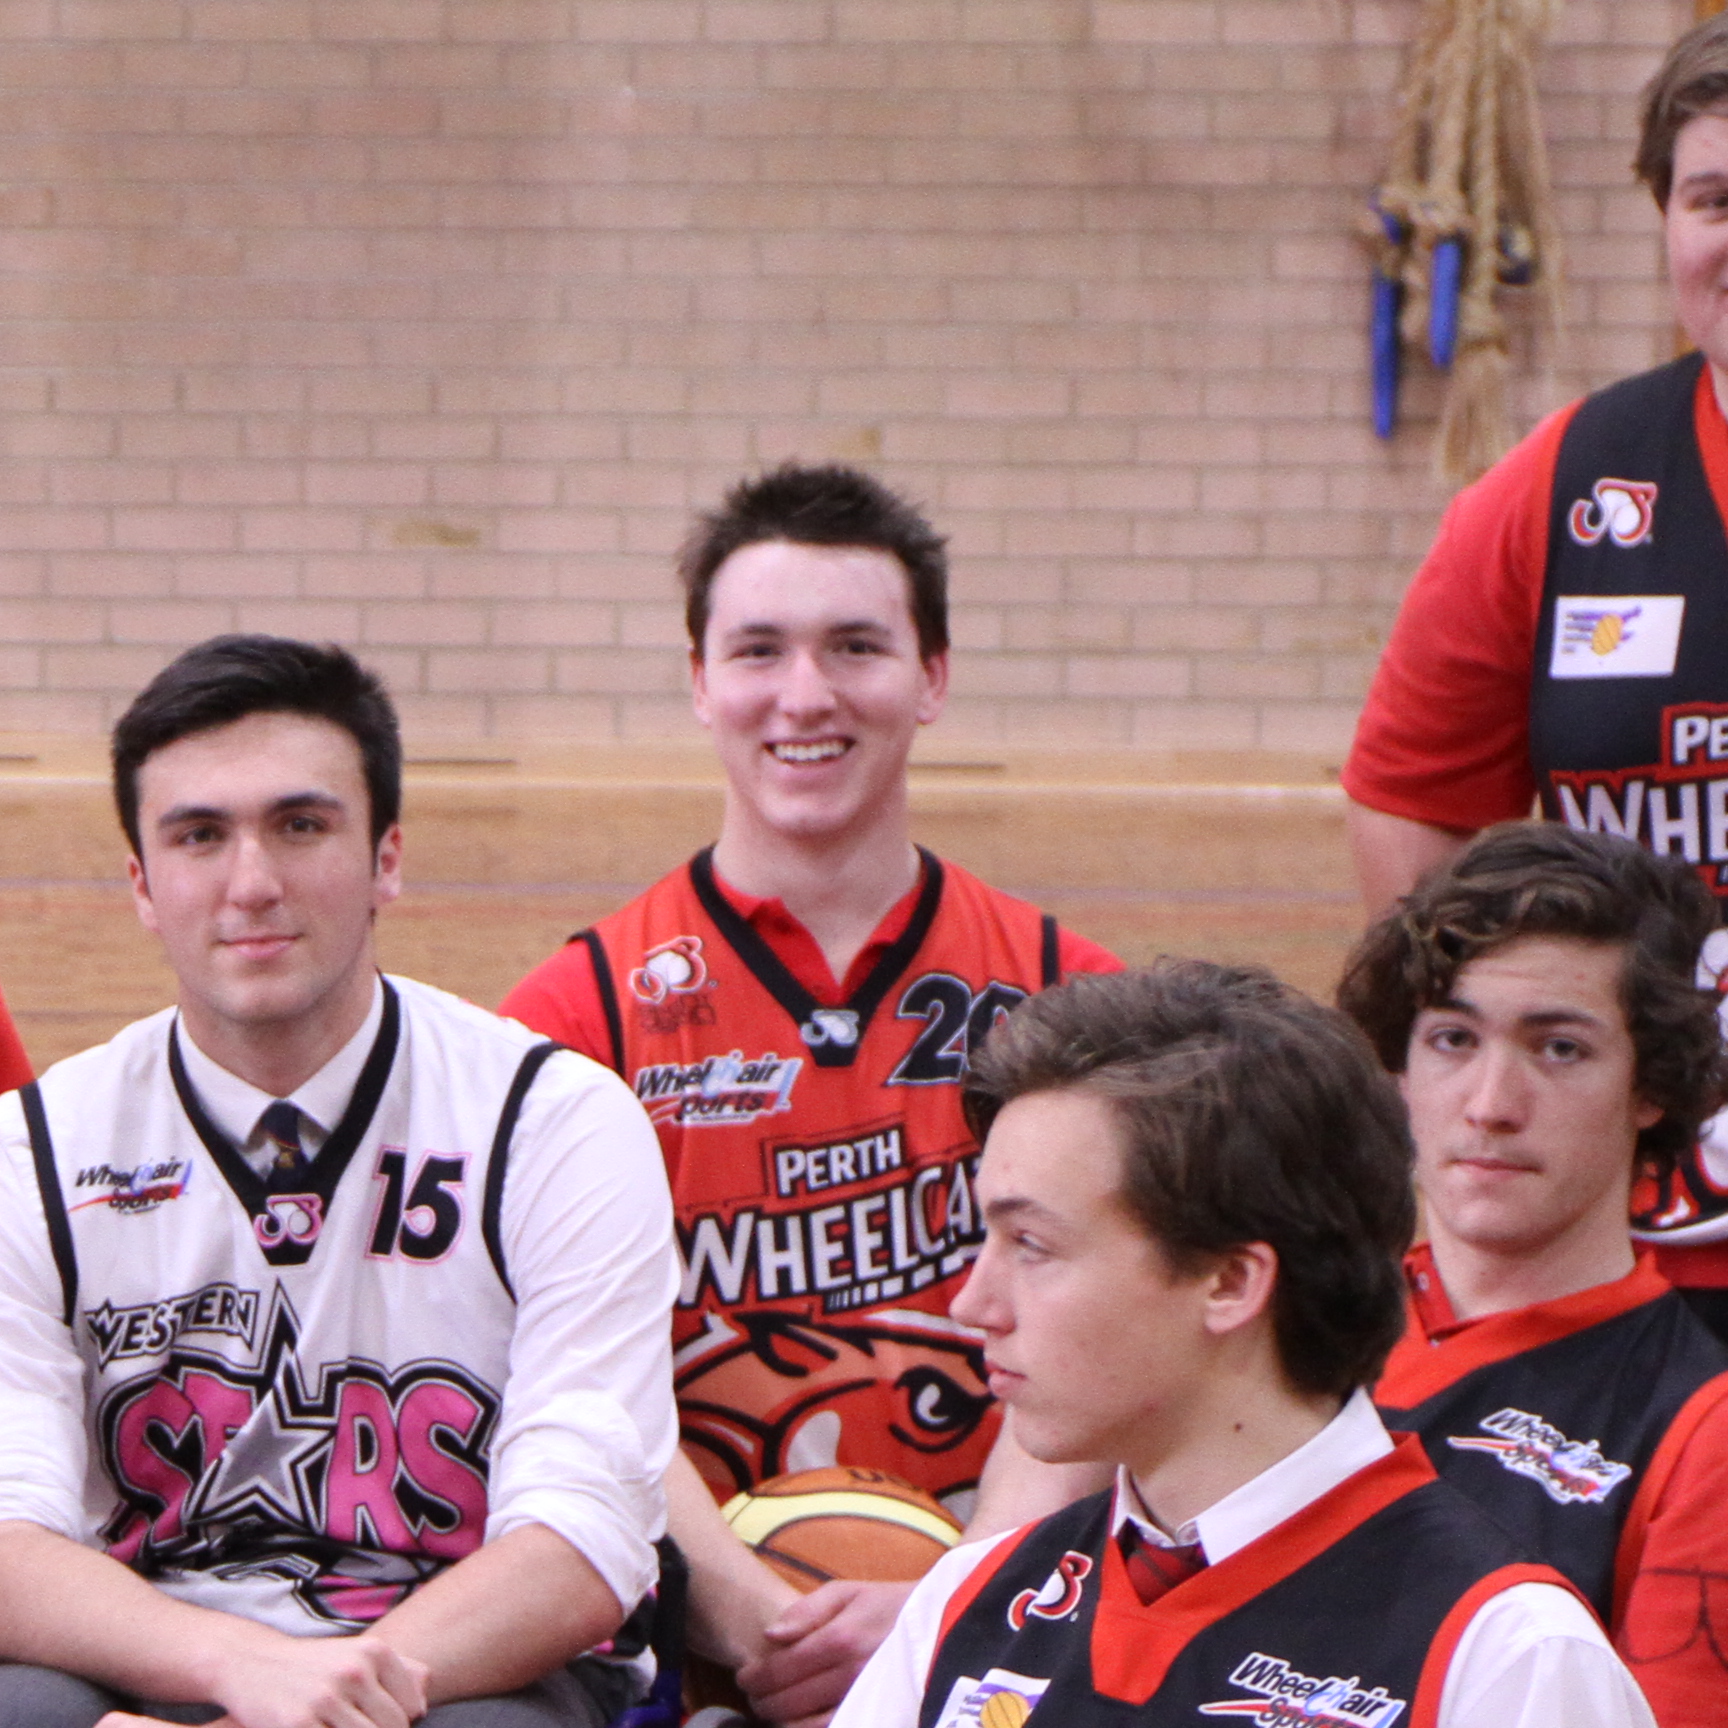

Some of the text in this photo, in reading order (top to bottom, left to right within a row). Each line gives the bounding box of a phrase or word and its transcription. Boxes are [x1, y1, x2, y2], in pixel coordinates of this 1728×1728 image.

[675, 1092, 765, 1121] ports
[366, 1147, 472, 1264] 15
[776, 1130, 903, 1197] PERTH
[674, 1160, 987, 1307] WHEELCA
[86, 1286, 259, 1370] WESTERN
